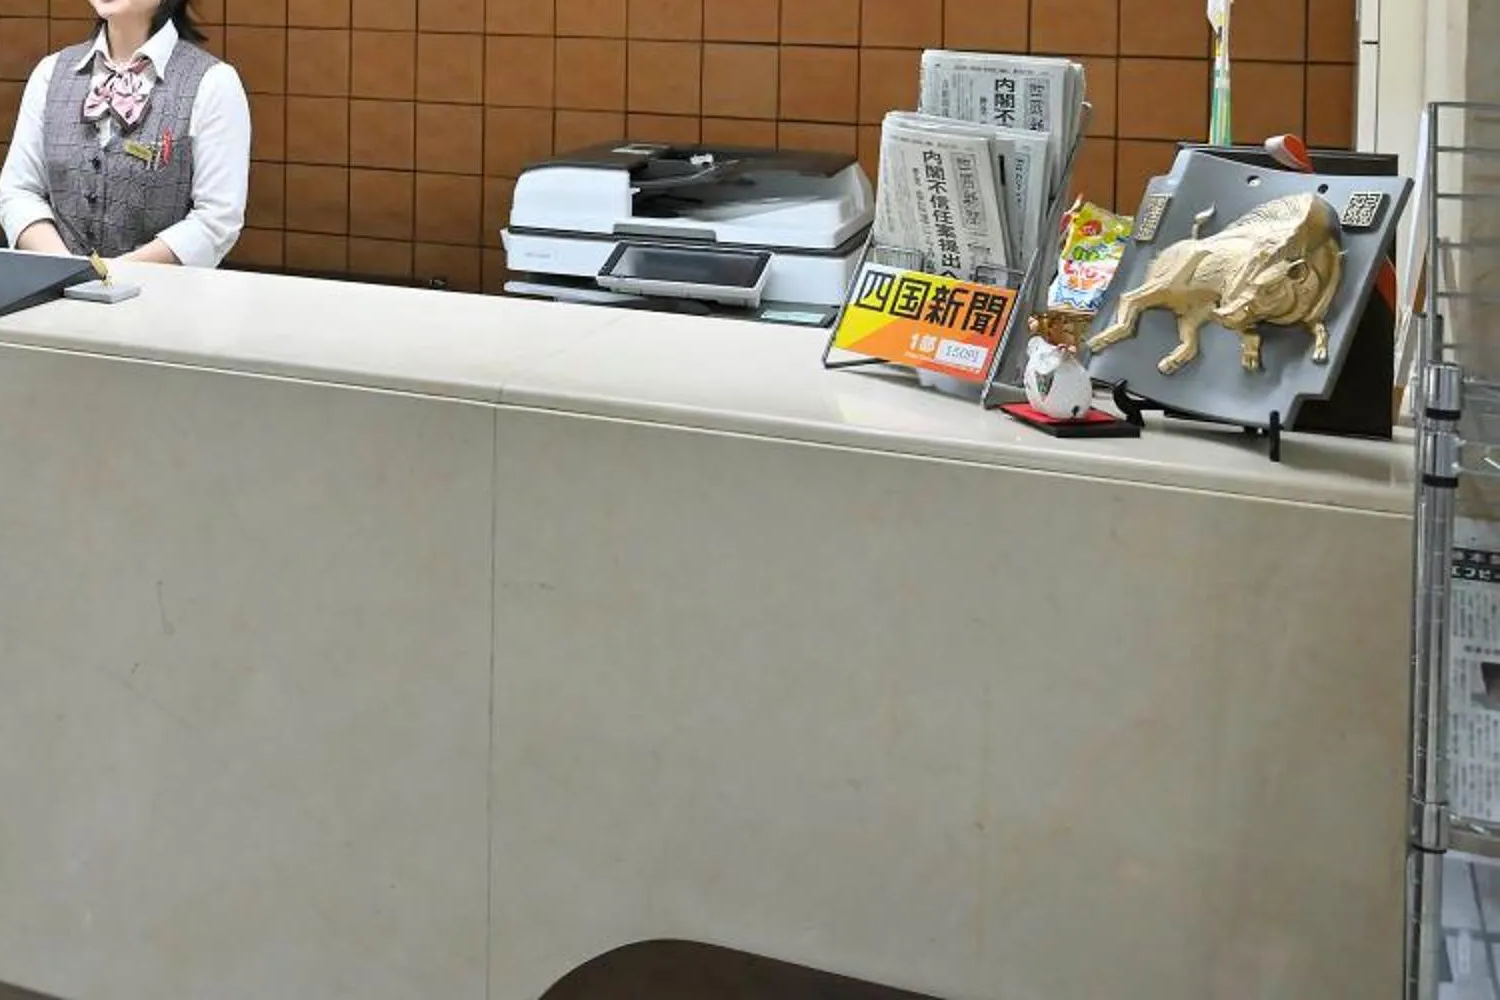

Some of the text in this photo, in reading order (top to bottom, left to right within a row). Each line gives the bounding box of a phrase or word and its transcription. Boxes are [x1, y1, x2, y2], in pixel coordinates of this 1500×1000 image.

[994, 77, 1016, 128] 内閣不
[854, 269, 1008, 337] 四国新聞
